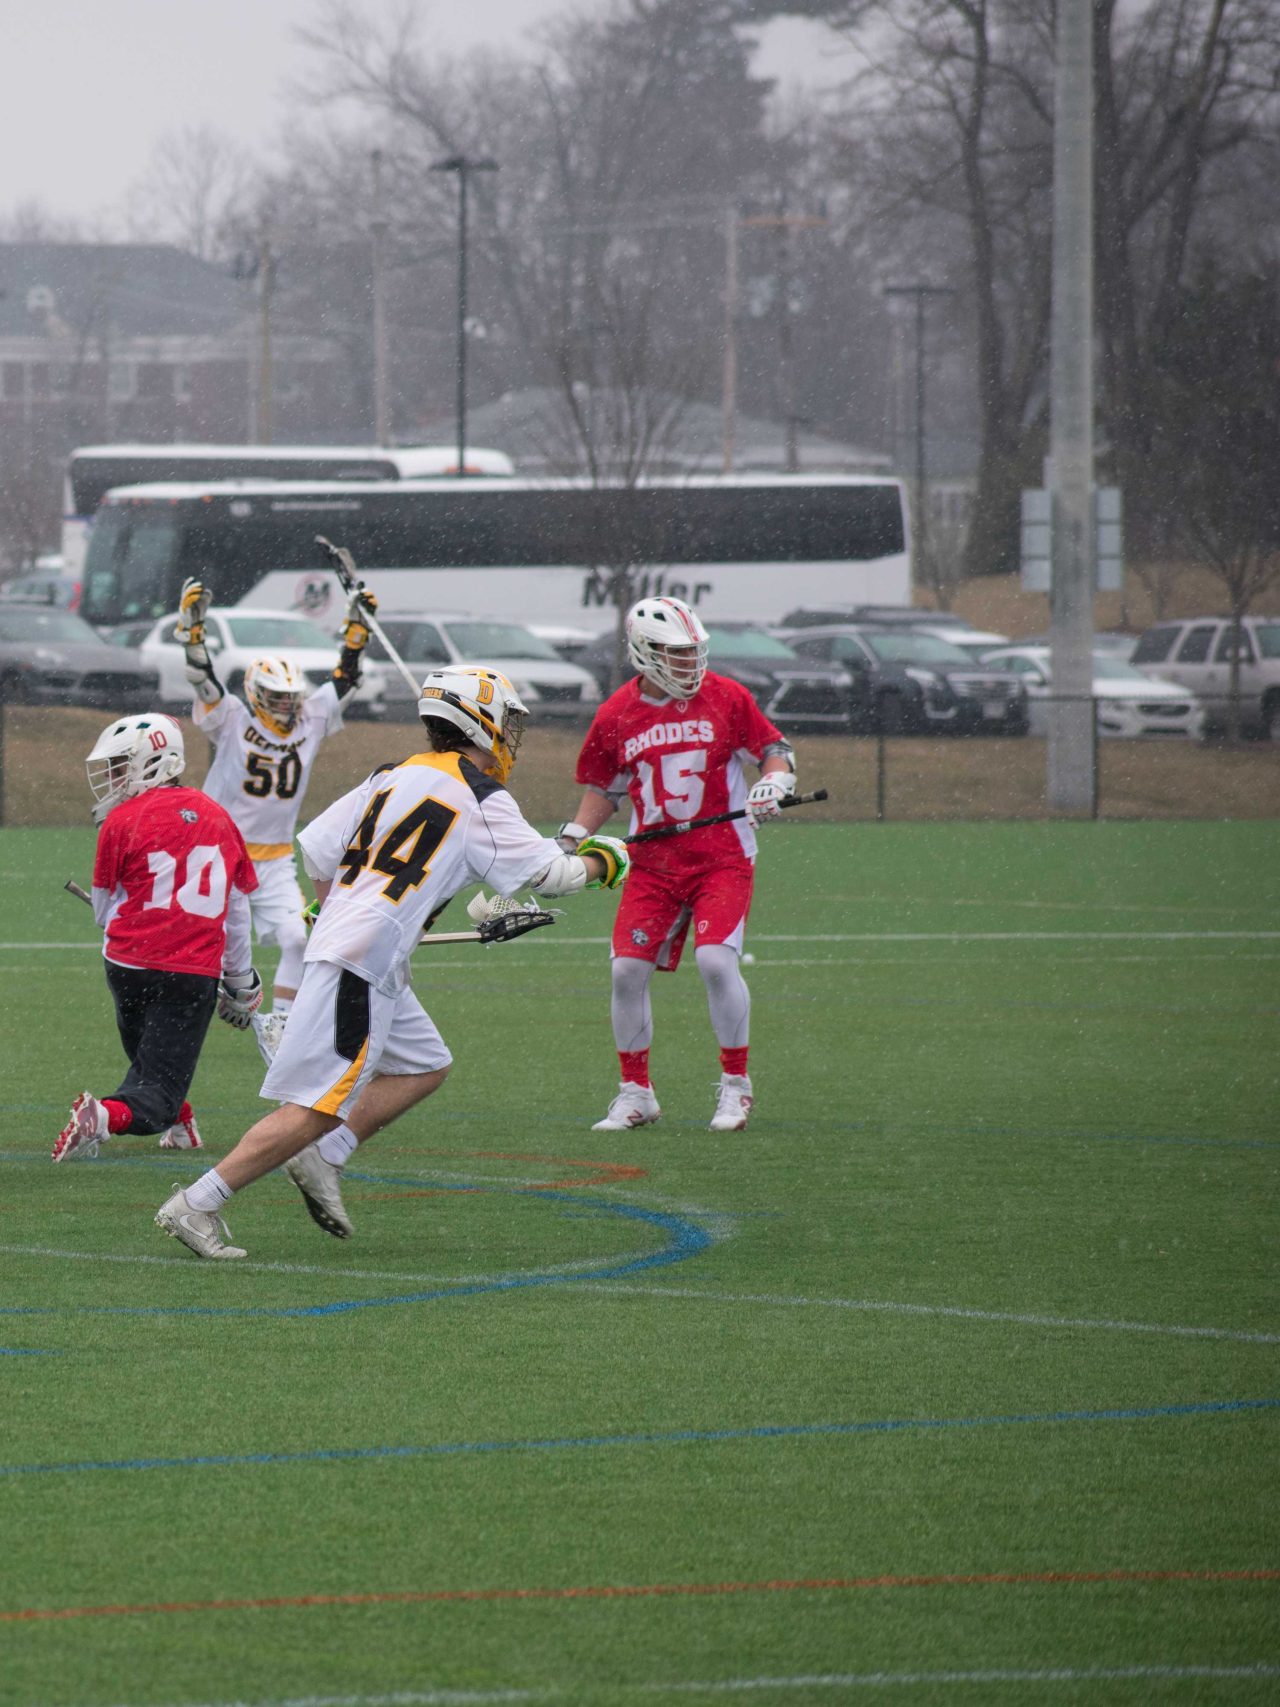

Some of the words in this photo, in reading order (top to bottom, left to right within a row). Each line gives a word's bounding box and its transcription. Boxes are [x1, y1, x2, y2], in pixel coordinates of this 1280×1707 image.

[476, 679, 494, 705] D
[148, 730, 167, 751] 10
[624, 719, 714, 762] RHODES
[242, 749, 302, 799] 50
[636, 749, 707, 825] 15
[337, 785, 461, 906] 44
[143, 844, 227, 919] 10
